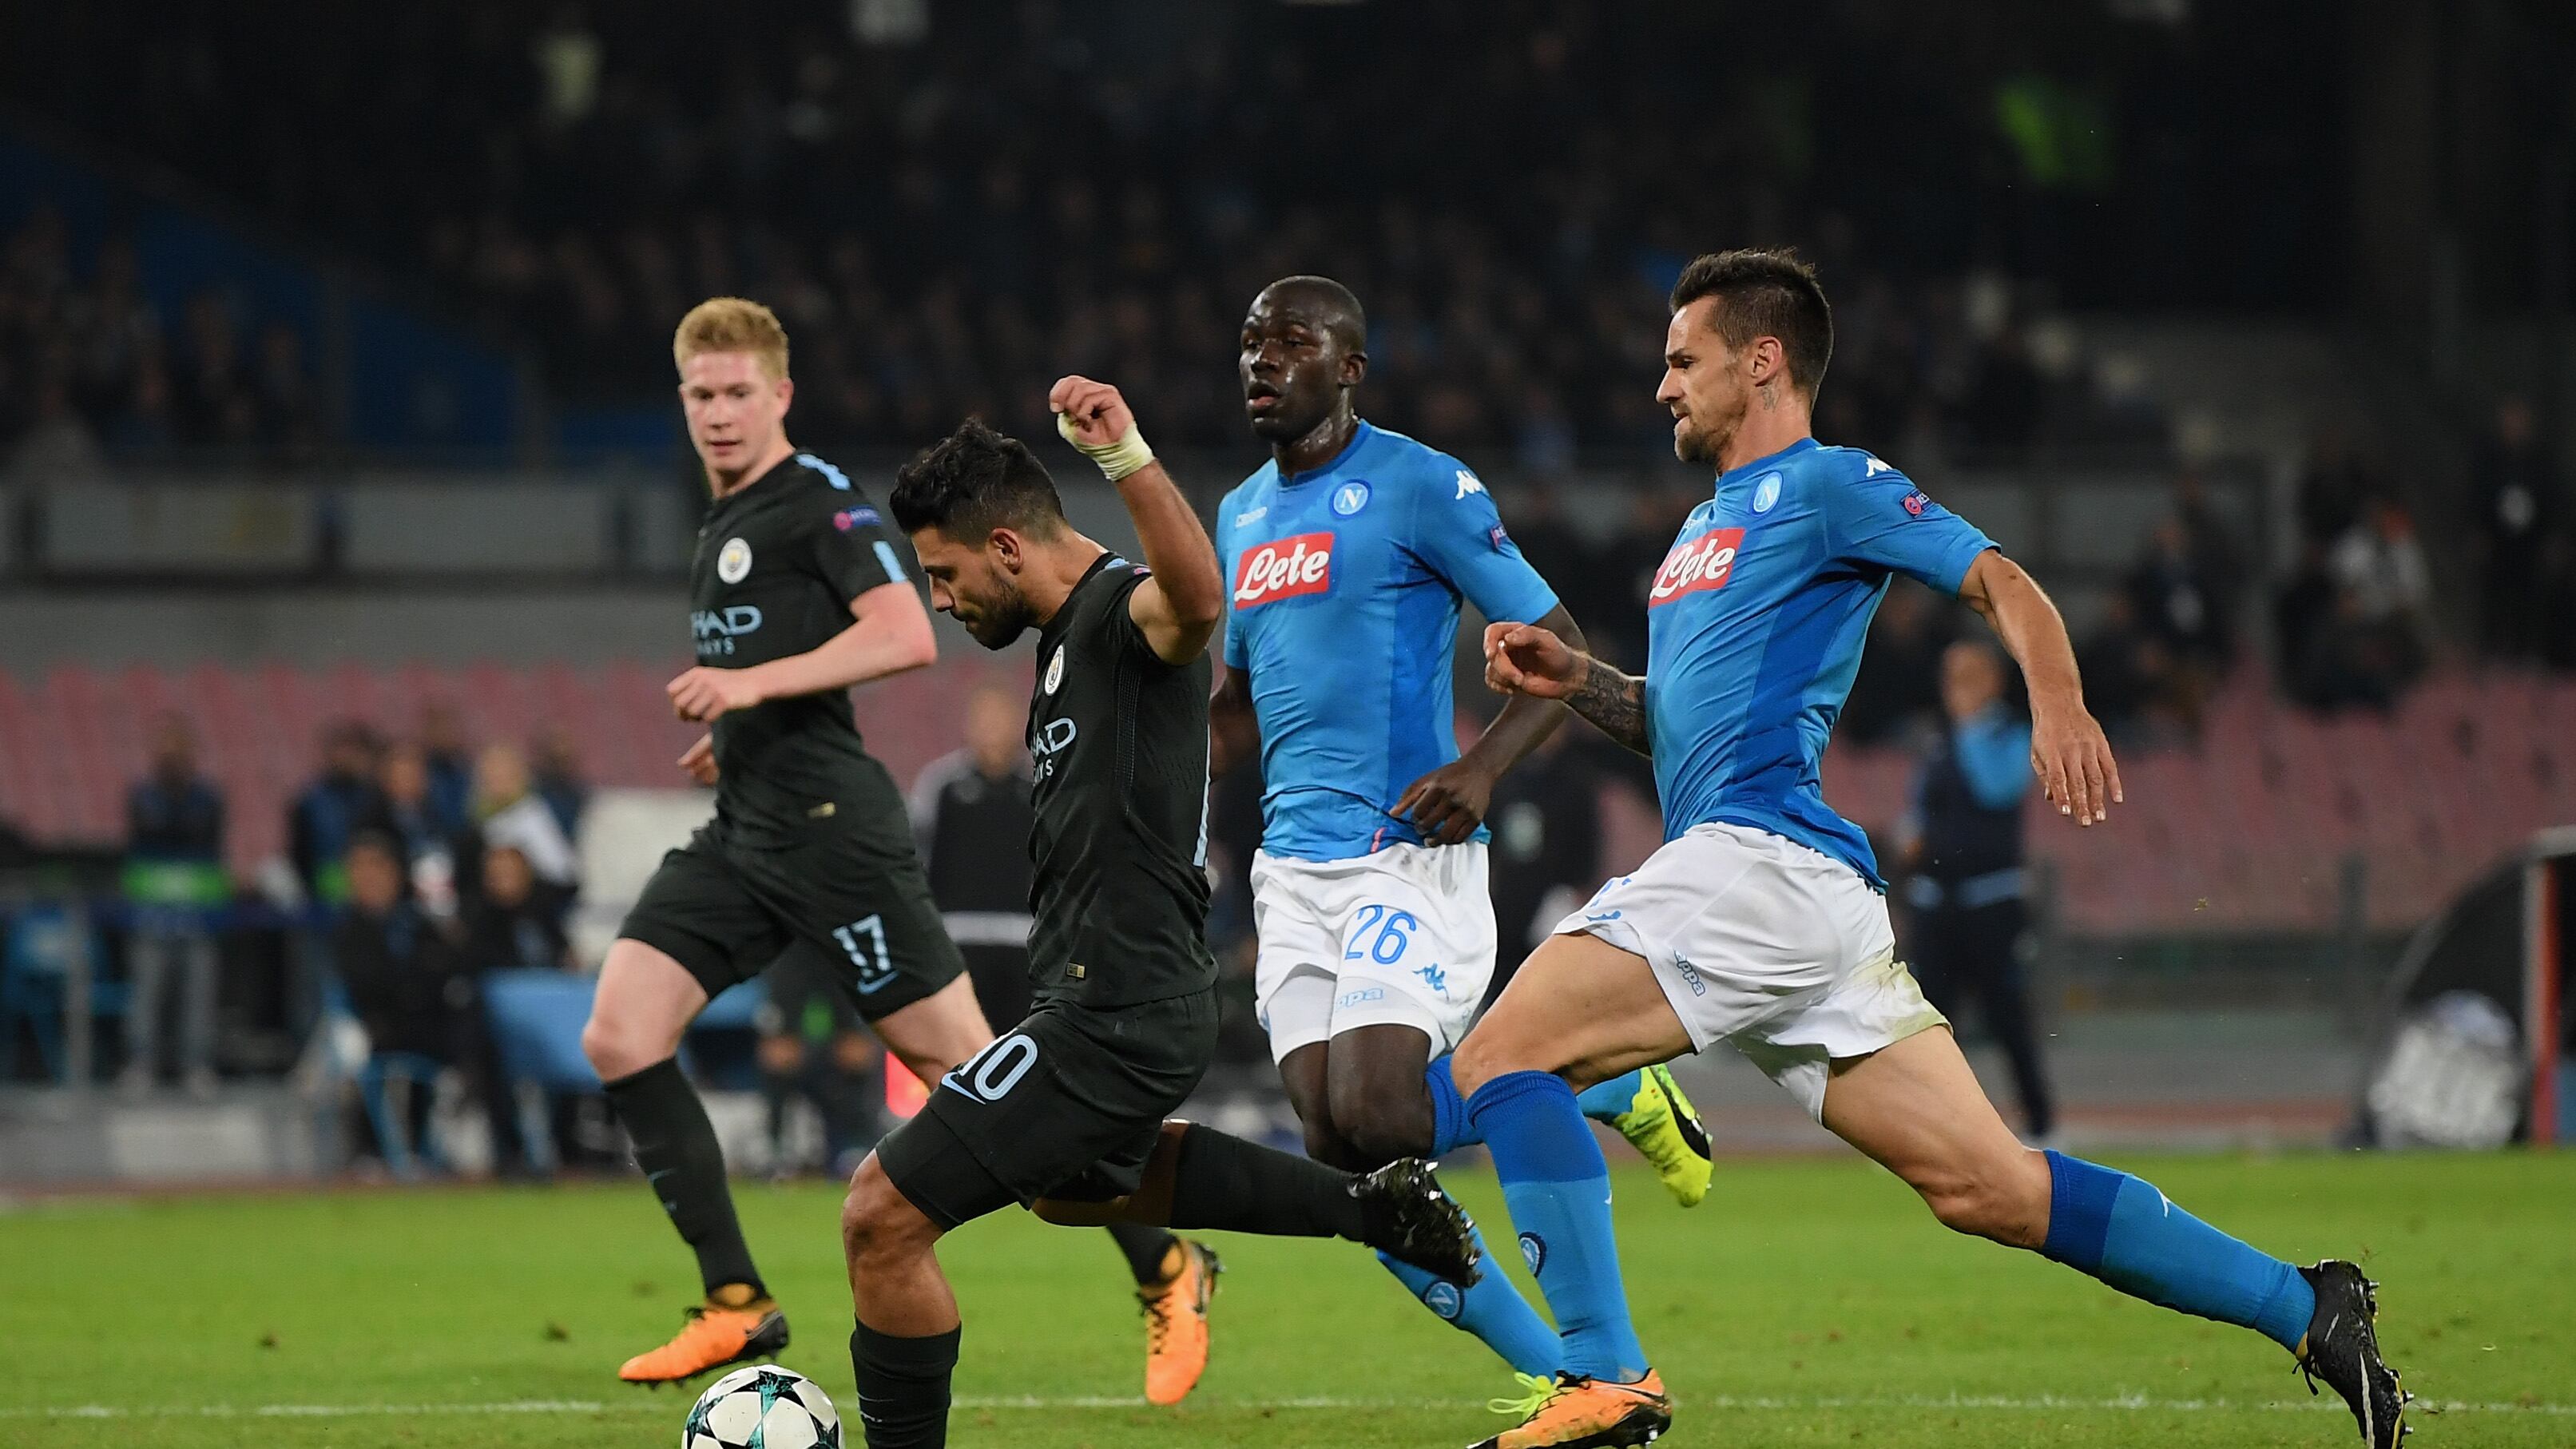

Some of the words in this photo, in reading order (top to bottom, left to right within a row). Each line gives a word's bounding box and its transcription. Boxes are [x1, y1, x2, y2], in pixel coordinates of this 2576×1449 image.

[1234, 542, 1330, 602] Lete
[1650, 538, 1735, 599] Lete
[832, 913, 892, 978] 17
[1344, 904, 1417, 965] 26
